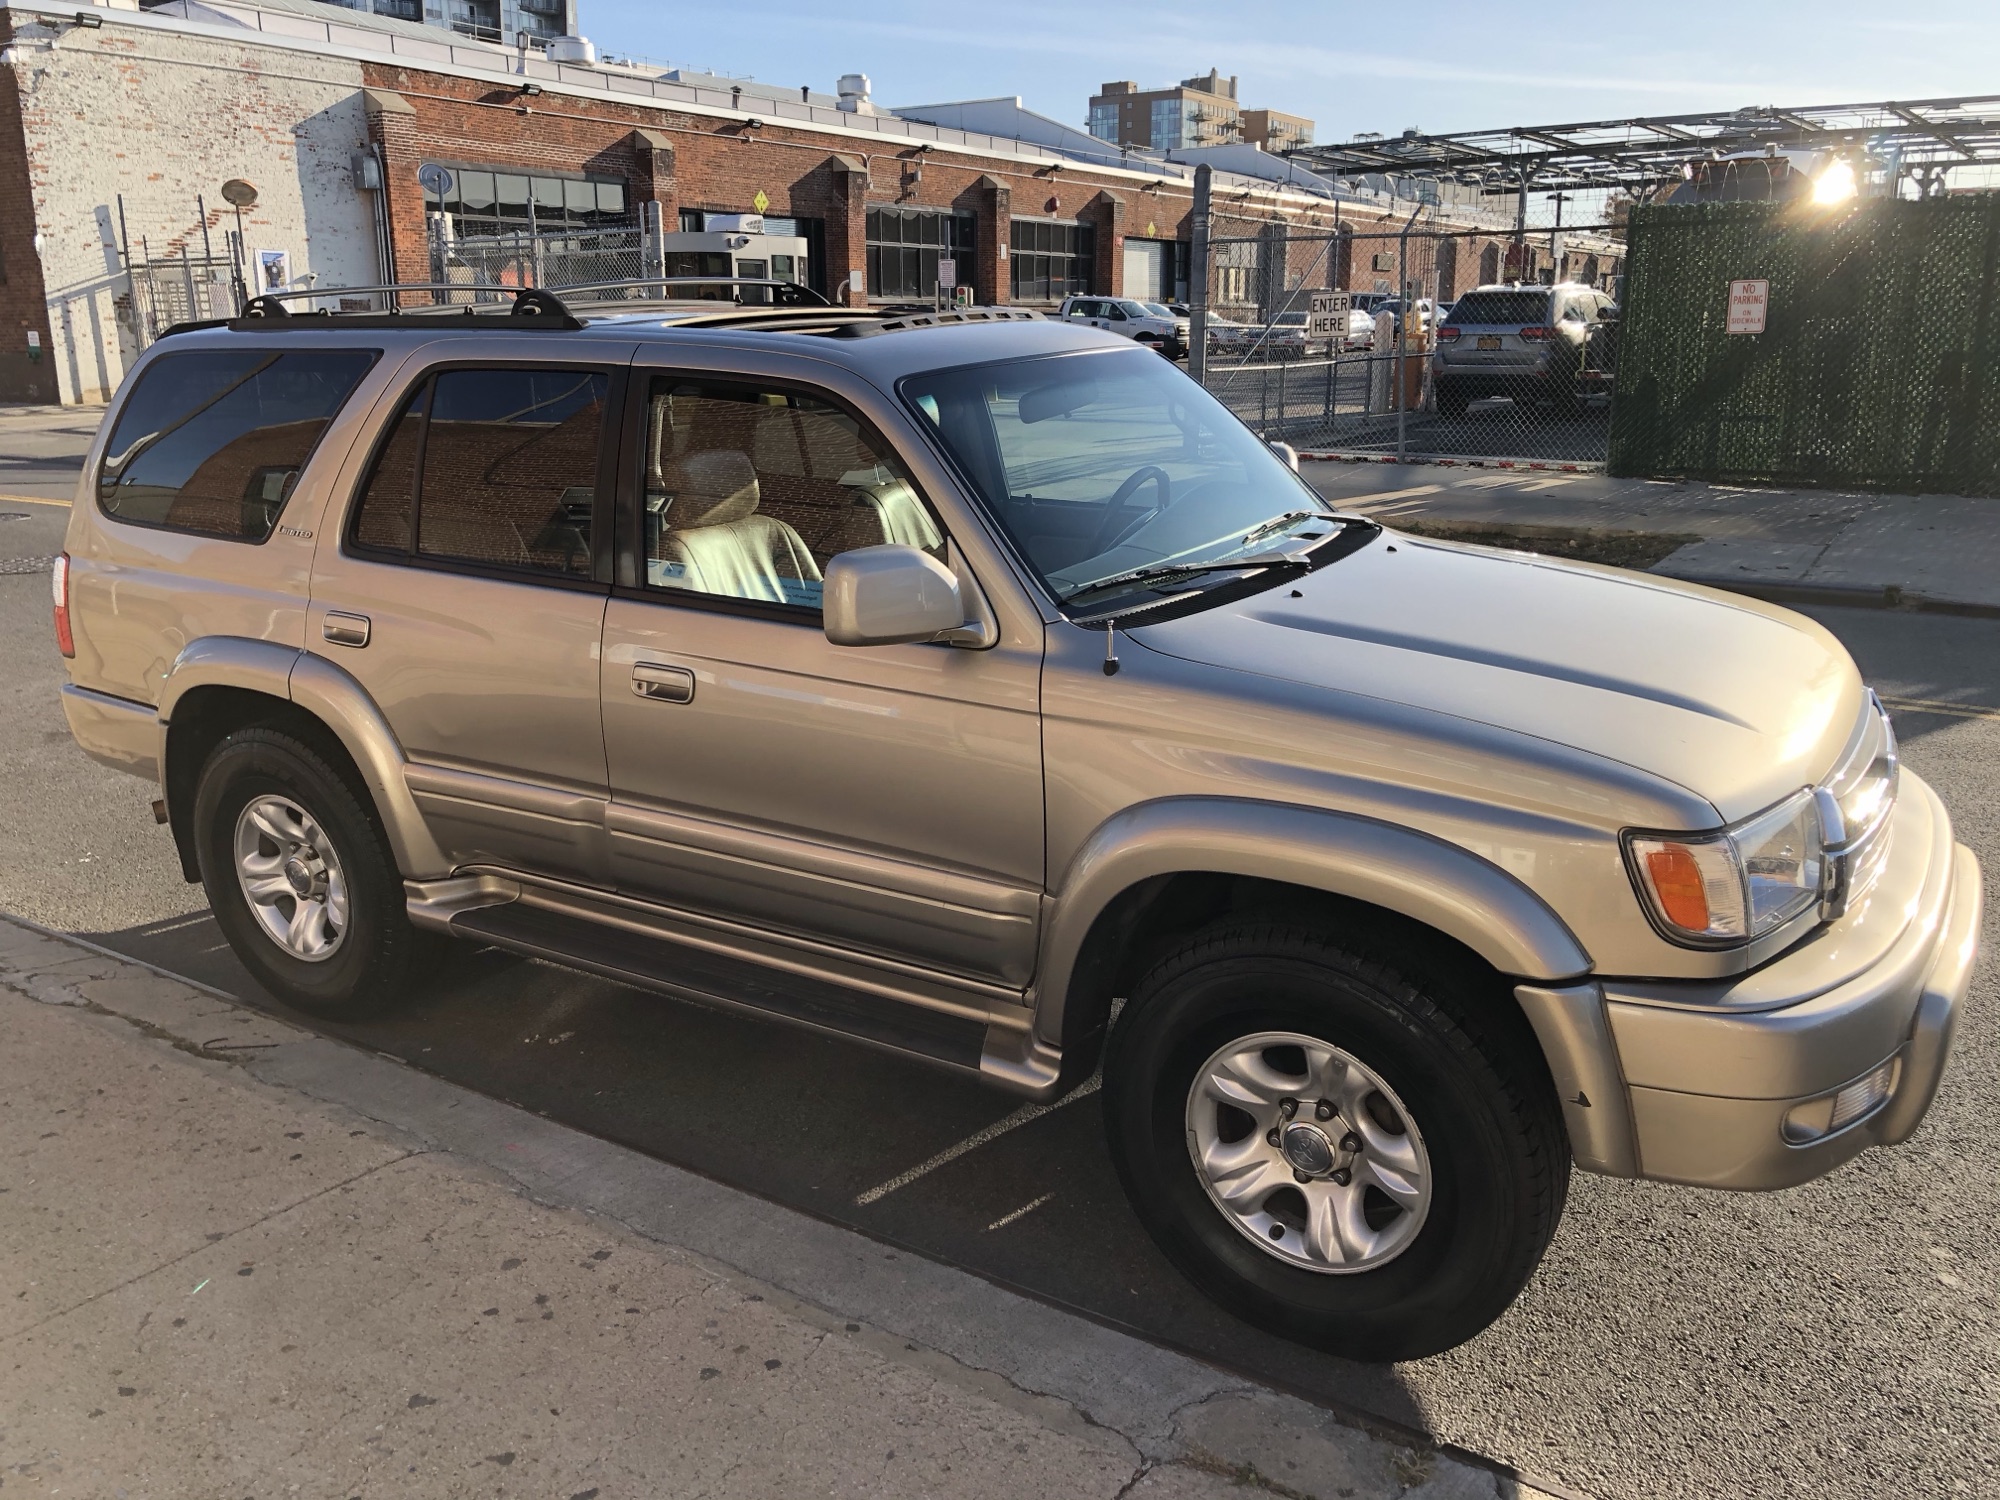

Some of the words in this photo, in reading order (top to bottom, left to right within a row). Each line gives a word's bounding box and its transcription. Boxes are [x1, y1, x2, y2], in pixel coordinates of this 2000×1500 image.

[1742, 284, 1756, 294] NO
[1312, 297, 1348, 313] ENTER
[1733, 295, 1763, 305] PARKING
[1314, 317, 1344, 332] HERE
[1731, 317, 1762, 325] SIDEWALK
